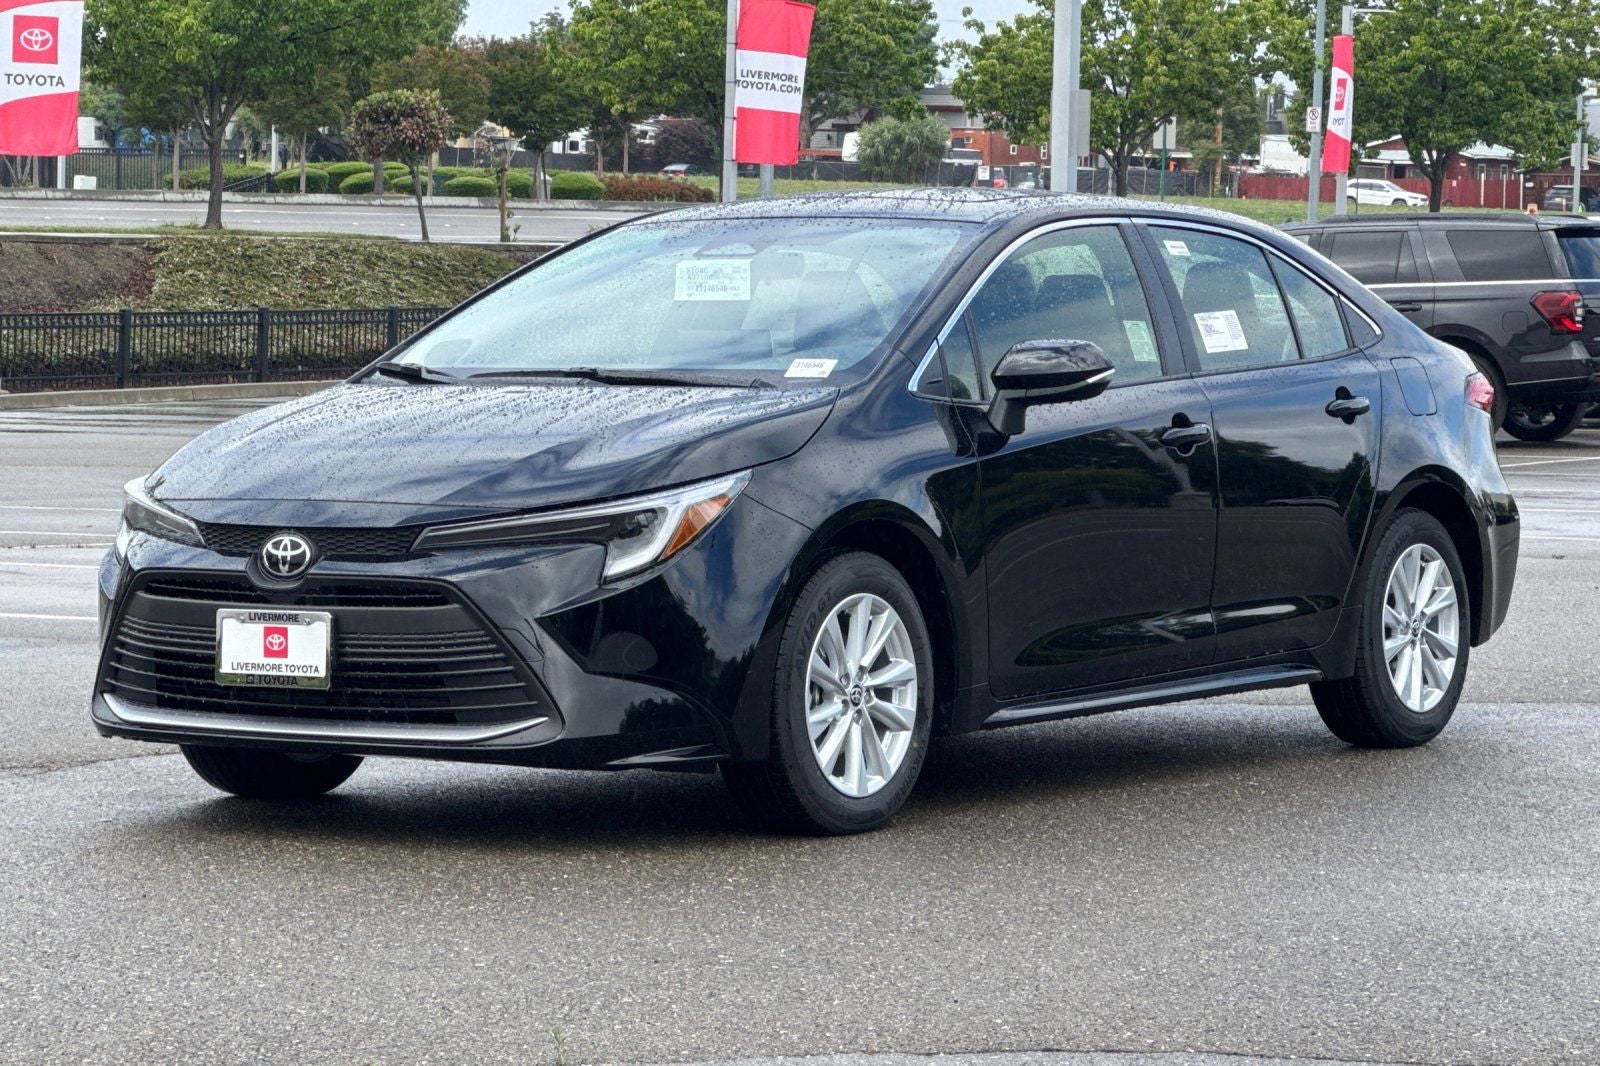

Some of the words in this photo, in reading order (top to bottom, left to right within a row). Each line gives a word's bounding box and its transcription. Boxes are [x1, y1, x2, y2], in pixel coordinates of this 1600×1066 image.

[4, 73, 65, 87] TOYOTA
[740, 69, 799, 84] LIVERMORE
[736, 79, 801, 95] TOYOTA.COM
[248, 612, 300, 623] LIVERMORE
[231, 662, 283, 673] LIVERMORE
[285, 664, 320, 674] TOYOTA
[257, 675, 298, 686] TOYOTA
